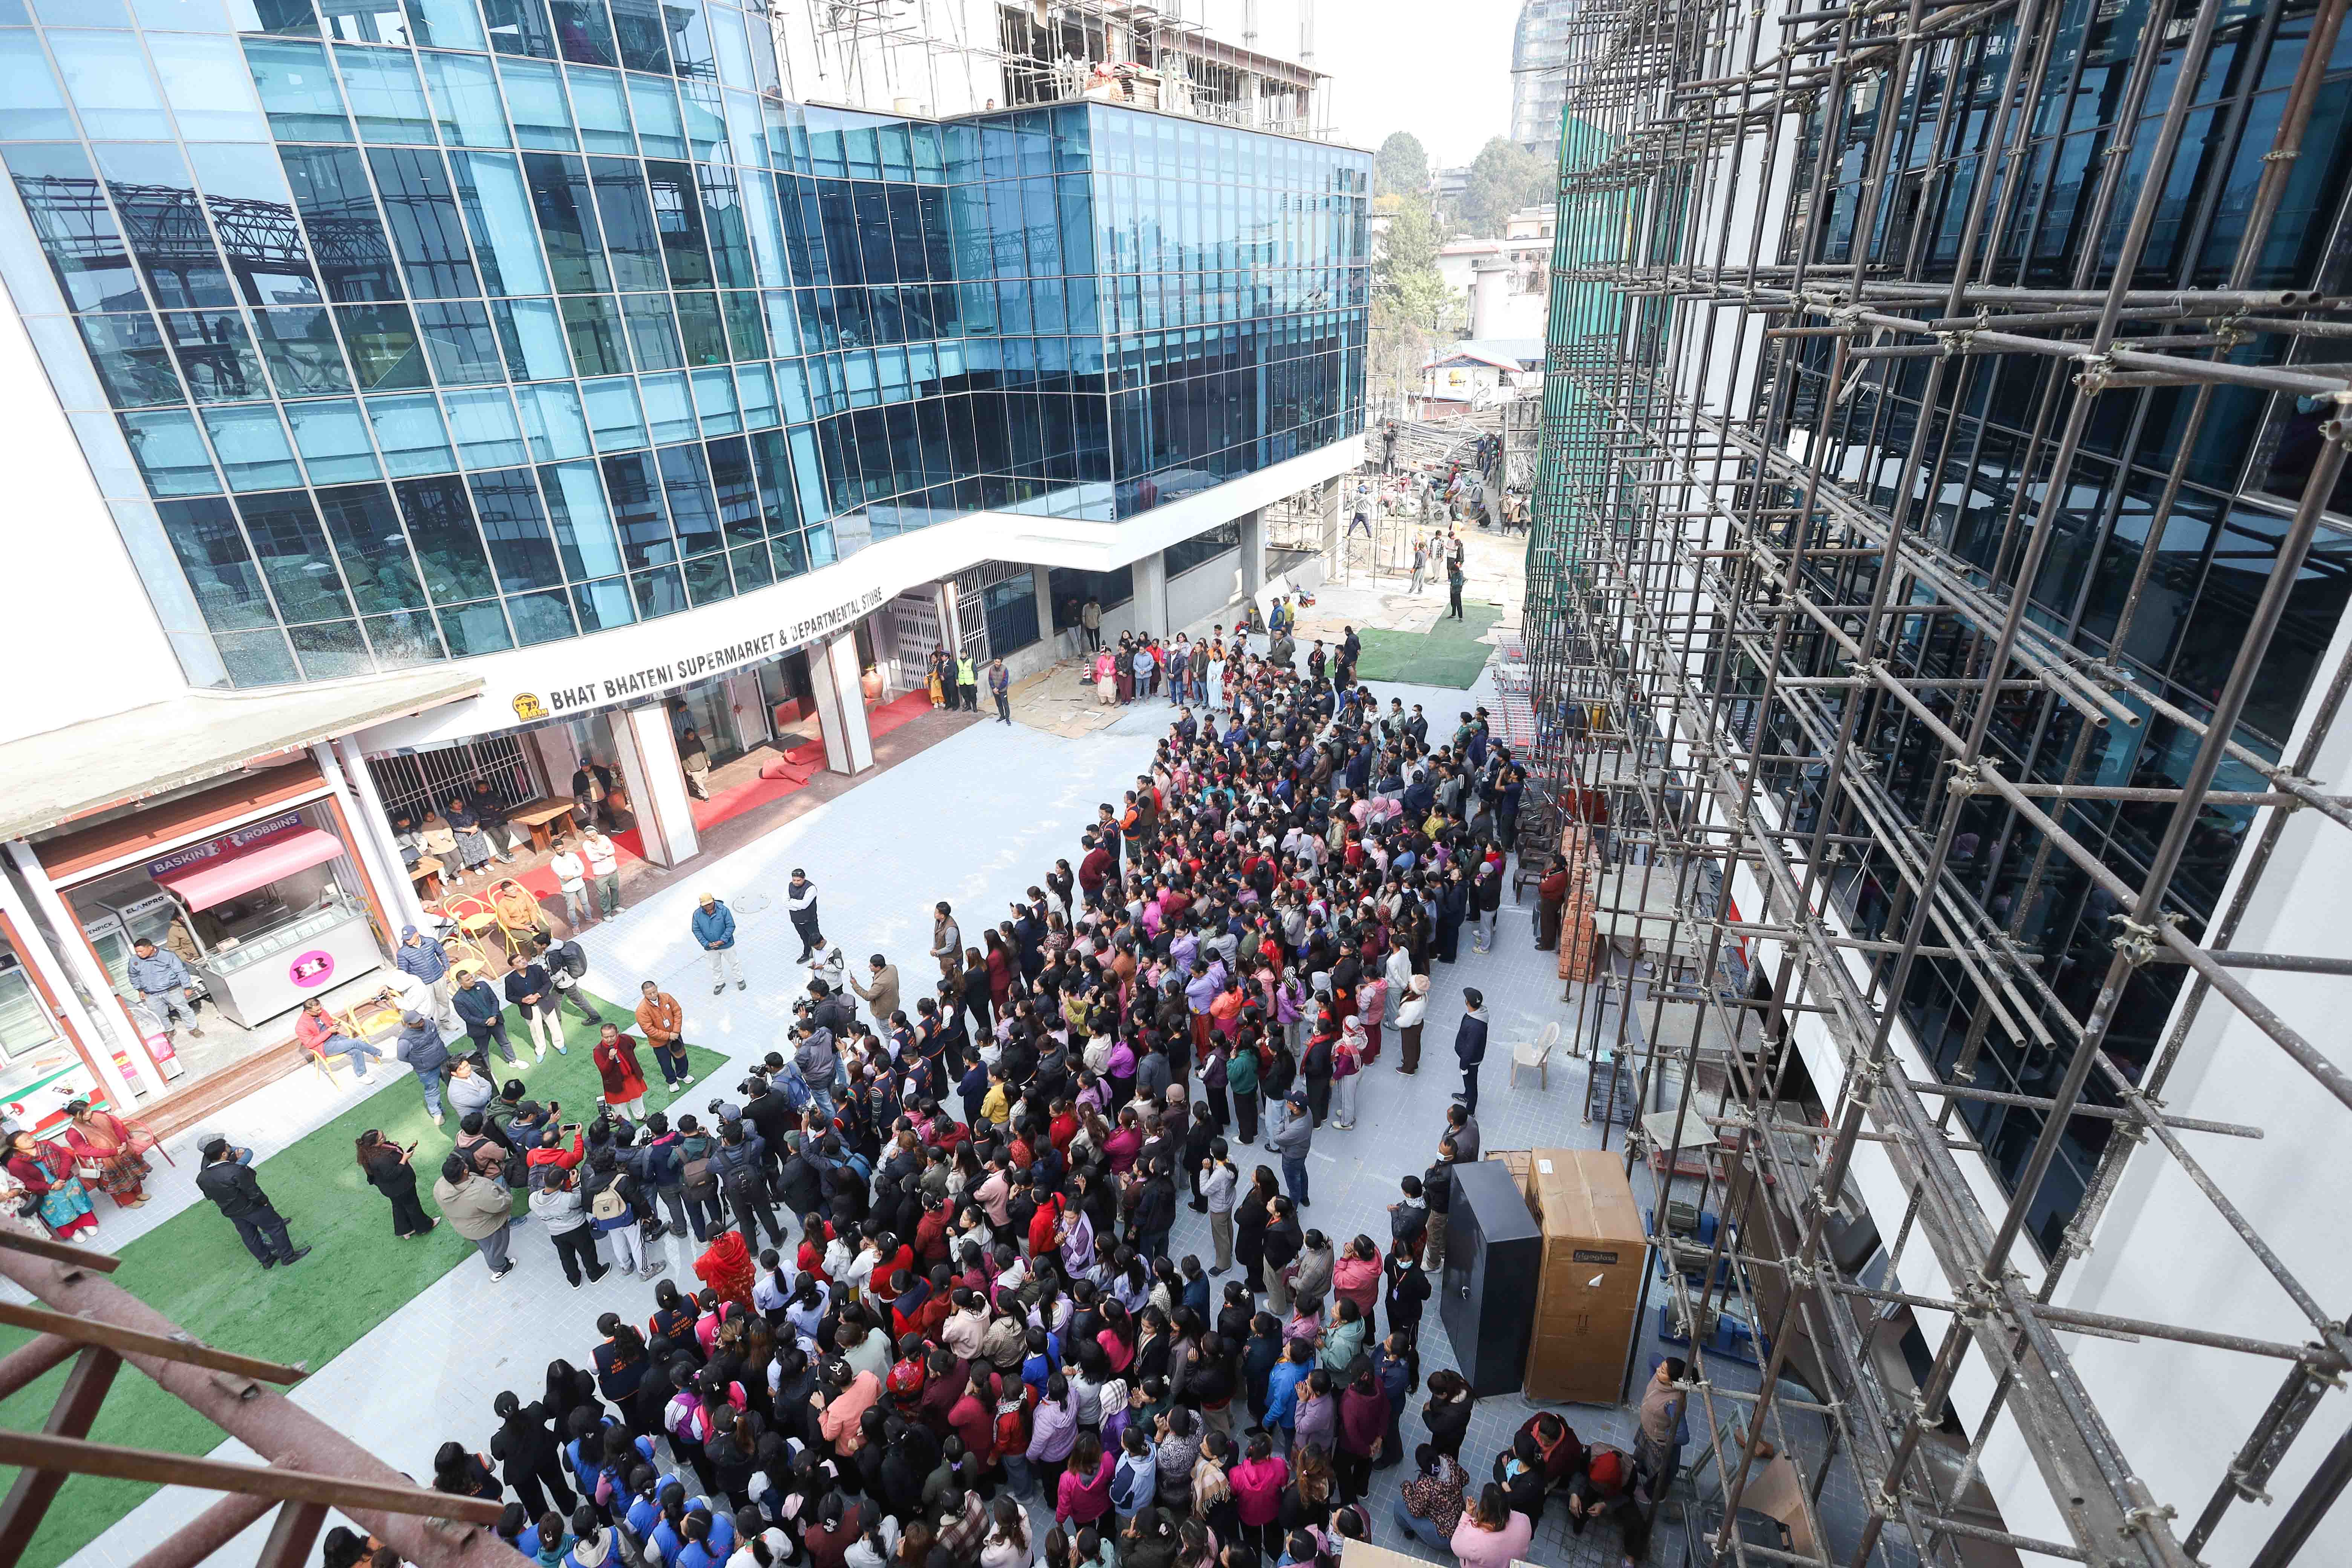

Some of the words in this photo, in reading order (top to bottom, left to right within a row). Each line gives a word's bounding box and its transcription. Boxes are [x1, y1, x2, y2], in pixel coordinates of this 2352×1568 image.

[550, 684, 596, 710] BHAT
[604, 665, 674, 698] BHATENI
[678, 633, 775, 678] SUPERMARKET
[779, 629, 787, 646] &
[790, 599, 860, 642] DEPARTMENTAL
[862, 586, 882, 609] STORE
[154, 849, 205, 873] BASKIN
[245, 816, 298, 841] ROBBINS
[126, 896, 164, 914] ELANPRO
[1576, 1252, 1615, 1261] frigoglass
